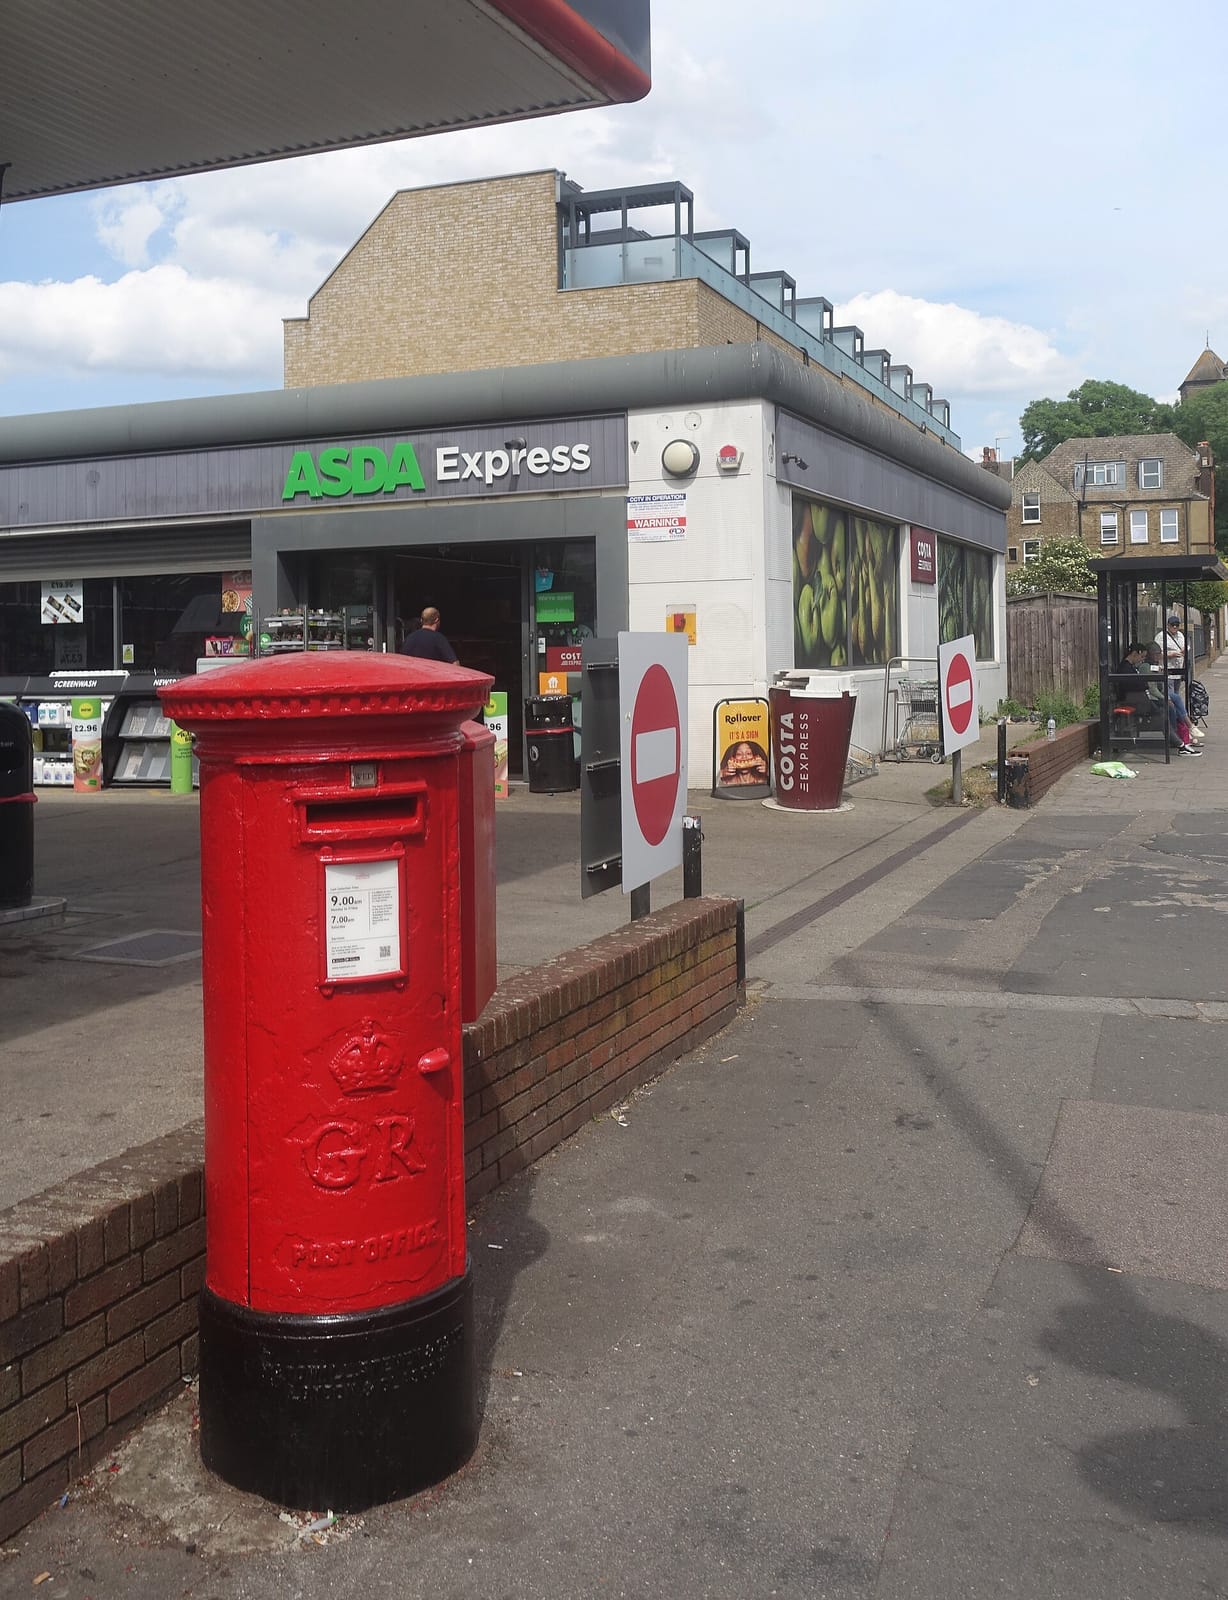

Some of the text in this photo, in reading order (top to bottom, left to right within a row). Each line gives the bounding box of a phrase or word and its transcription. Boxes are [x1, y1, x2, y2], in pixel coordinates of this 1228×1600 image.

[282, 442, 591, 499] ASDA Express
[634, 518, 680, 528] WARNING
[917, 541, 931, 559] COSTA
[53, 680, 97, 688] SCREENWASH
[74, 724, 98, 732] £2.96
[725, 714, 762, 724] Rollover
[729, 730, 759, 740] IT'S A SIGN
[780, 713, 796, 791] COSTA
[800, 713, 809, 781] EXPRESS
[304, 1116, 427, 1191] GR
[293, 1219, 439, 1268] POST OFFICE
